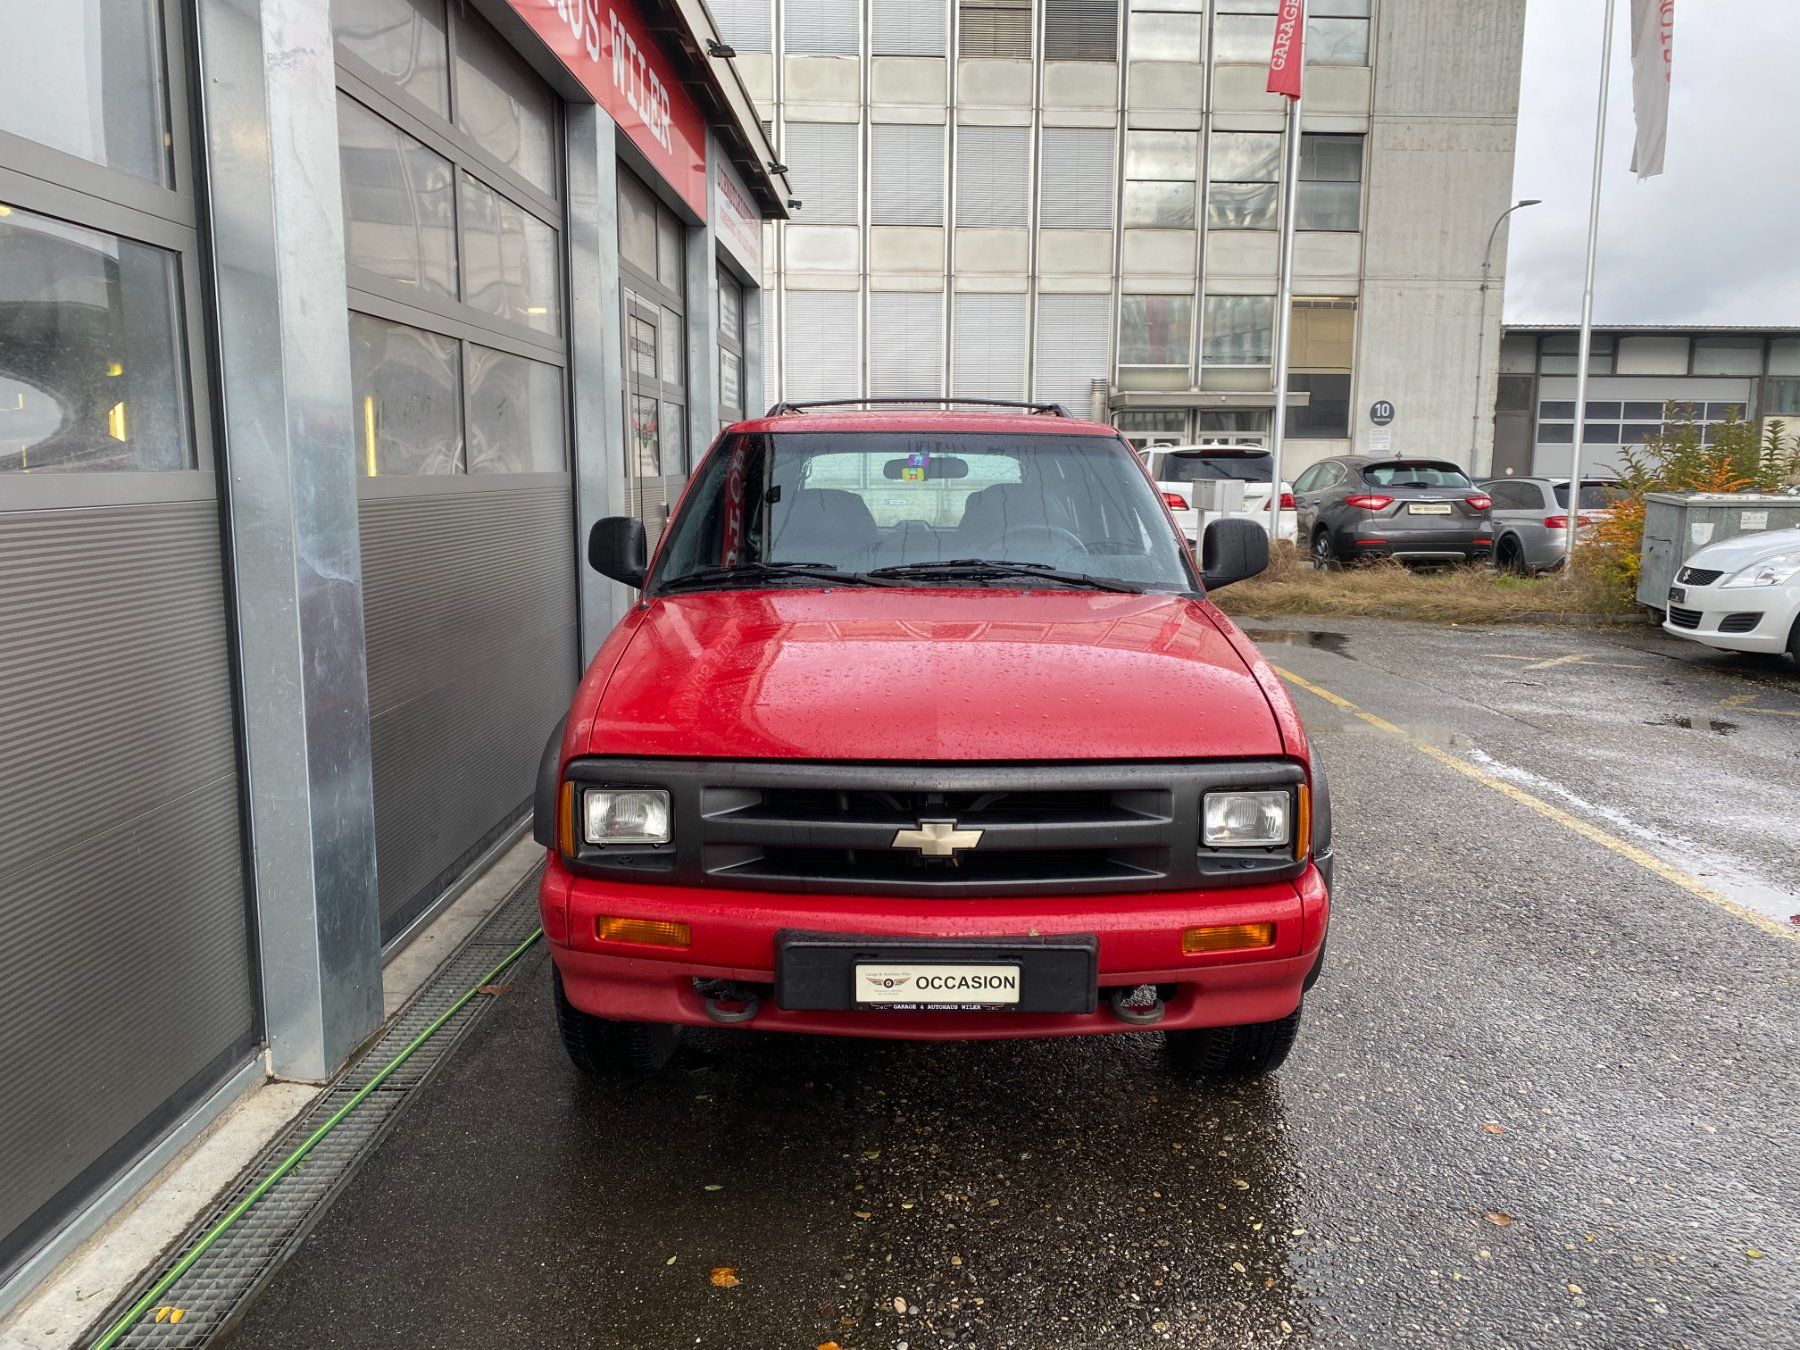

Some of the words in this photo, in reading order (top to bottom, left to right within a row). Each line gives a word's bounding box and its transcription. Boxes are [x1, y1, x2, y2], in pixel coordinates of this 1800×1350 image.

[1271, 0, 1300, 71] GARAGE
[609, 8, 672, 156] WILER
[1375, 403, 1390, 417] 10
[915, 975, 1016, 990] OCCASION
